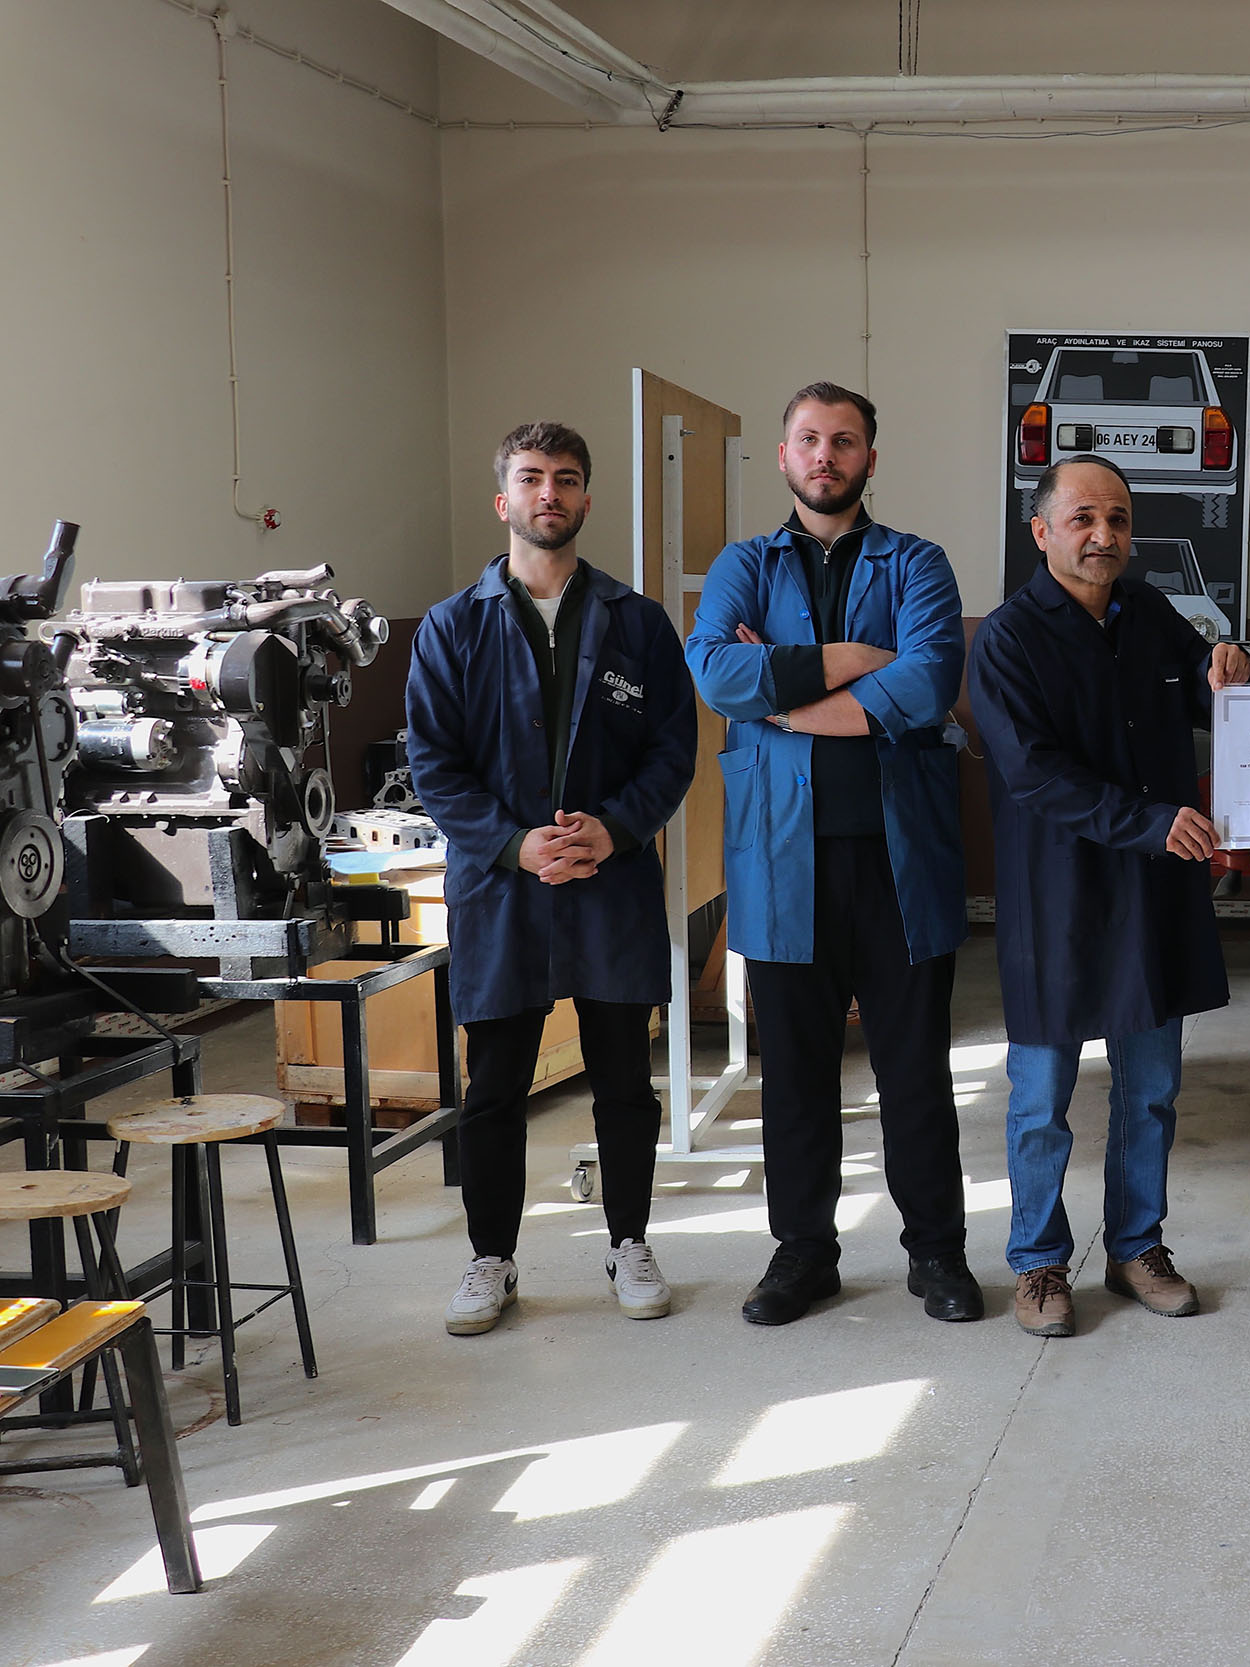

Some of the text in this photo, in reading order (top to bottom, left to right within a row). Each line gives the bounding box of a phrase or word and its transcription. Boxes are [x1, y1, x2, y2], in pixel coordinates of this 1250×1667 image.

[1036, 337, 1058, 346] ARAÇ
[1063, 338, 1110, 346] AYDINLATMA
[1156, 339, 1186, 347] SİSTEMİ
[1191, 340, 1223, 348] PANOSU
[1096, 433, 1156, 447] 06 AEY 24
[141, 627, 185, 638] Perkins
[603, 671, 643, 697] Günel
